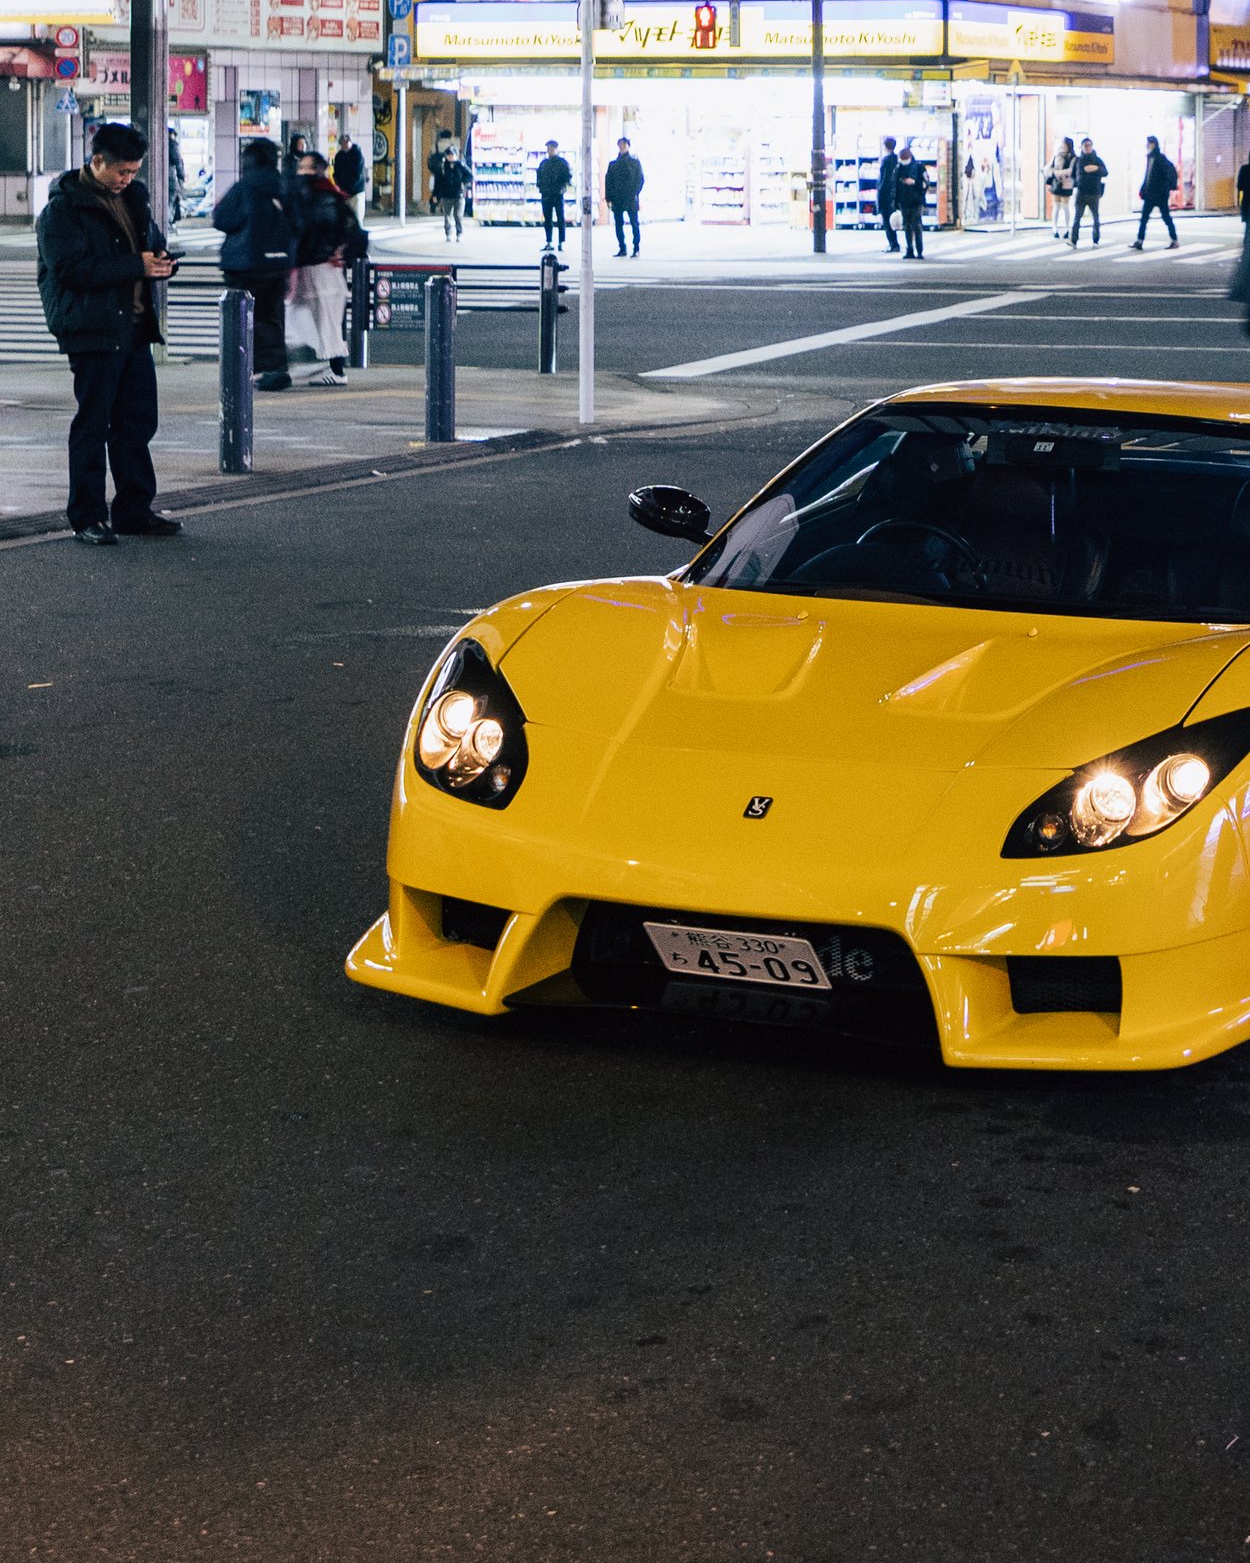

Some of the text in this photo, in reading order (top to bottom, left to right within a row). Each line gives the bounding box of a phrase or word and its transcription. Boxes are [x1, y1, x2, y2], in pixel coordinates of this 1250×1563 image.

[443, 33, 582, 47] Matsumoto KiYosh
[764, 31, 917, 45] Matsuoto KiYoshi
[686, 931, 780, 954] 熊谷 330
[671, 951, 688, 965] ち
[698, 949, 820, 985] 45-09
